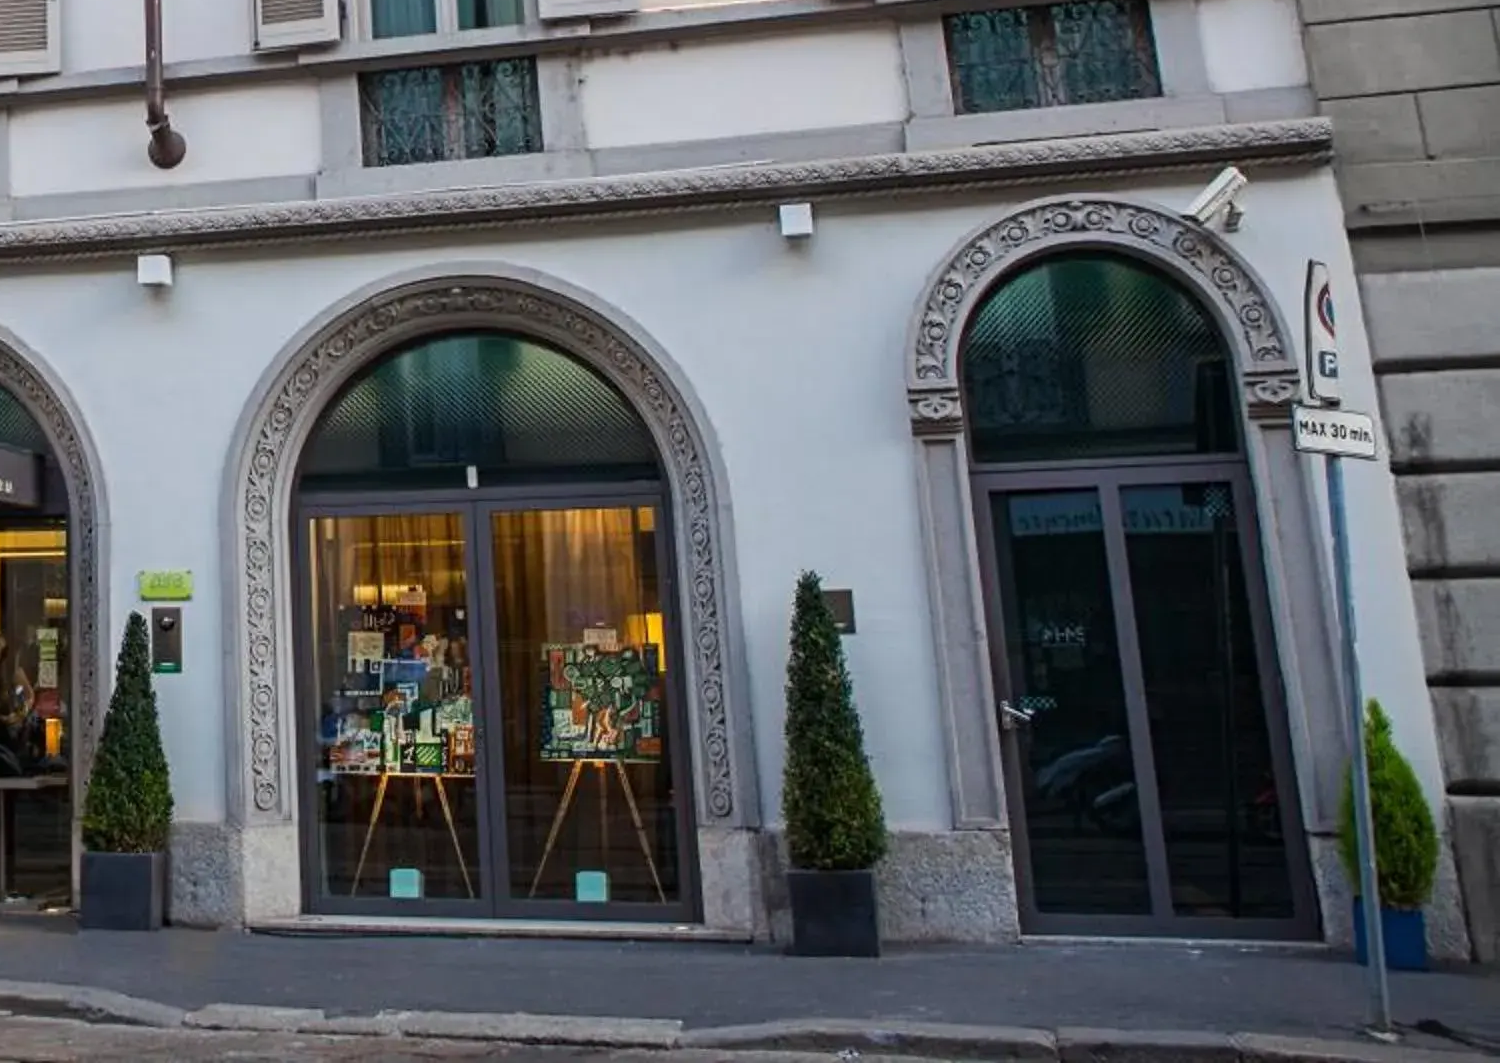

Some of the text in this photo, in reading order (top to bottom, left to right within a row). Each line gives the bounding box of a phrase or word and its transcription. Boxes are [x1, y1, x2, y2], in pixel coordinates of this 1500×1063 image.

[1299, 420, 1373, 443] MAX 30 min.
